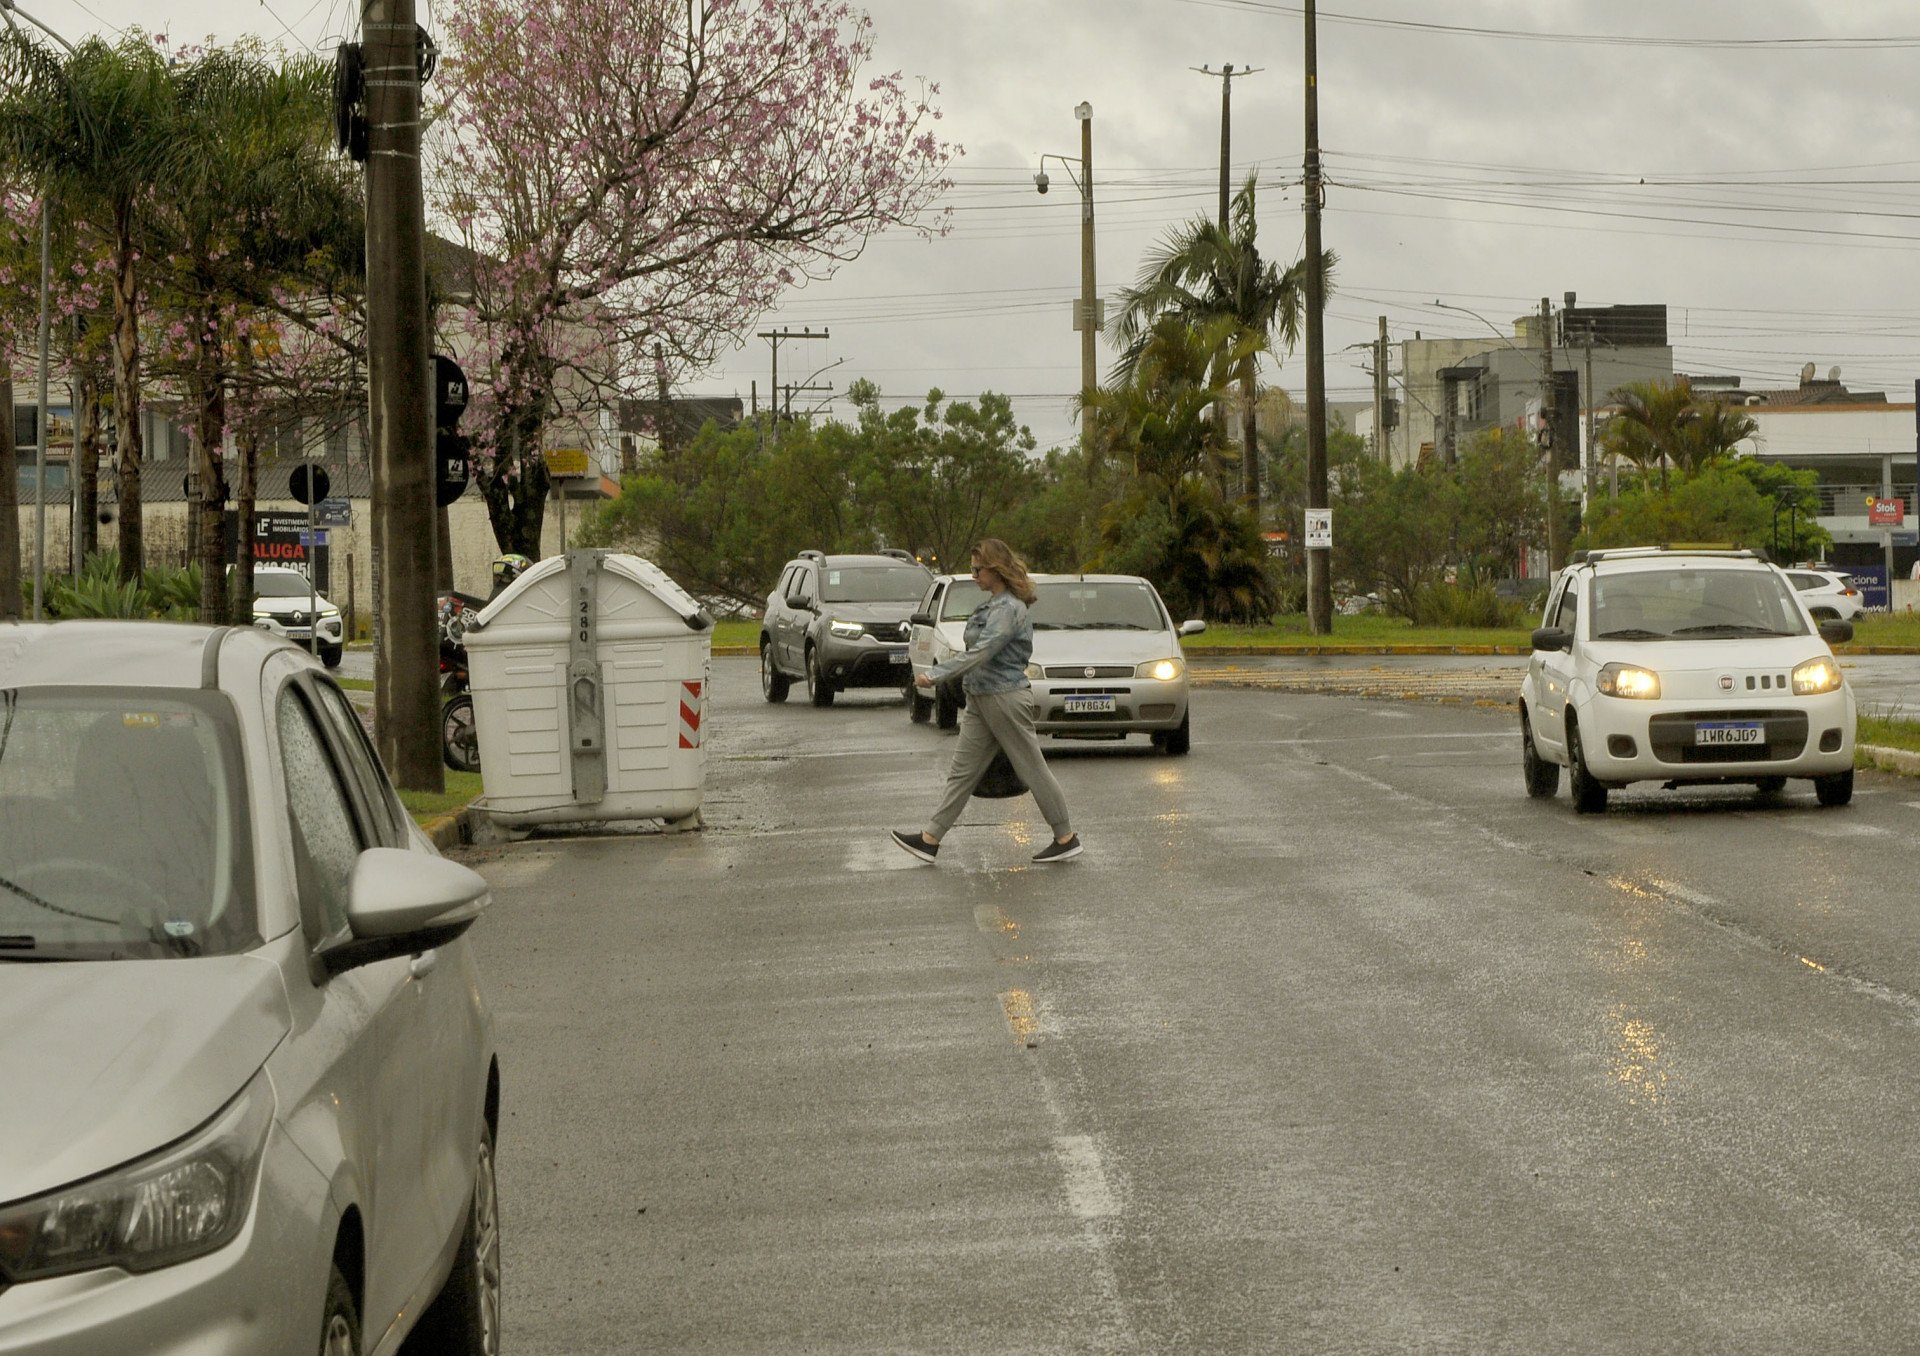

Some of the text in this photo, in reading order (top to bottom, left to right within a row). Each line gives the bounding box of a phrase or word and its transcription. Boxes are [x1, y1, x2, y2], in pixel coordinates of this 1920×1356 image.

[1876, 503, 1896, 513] Stok
[254, 543, 305, 558] ALUGA
[1850, 574, 1878, 585] cione
[1862, 604, 1887, 613] anVel
[1069, 701, 1110, 711] IPY8G34
[1702, 729, 1757, 742] IWR6J09
